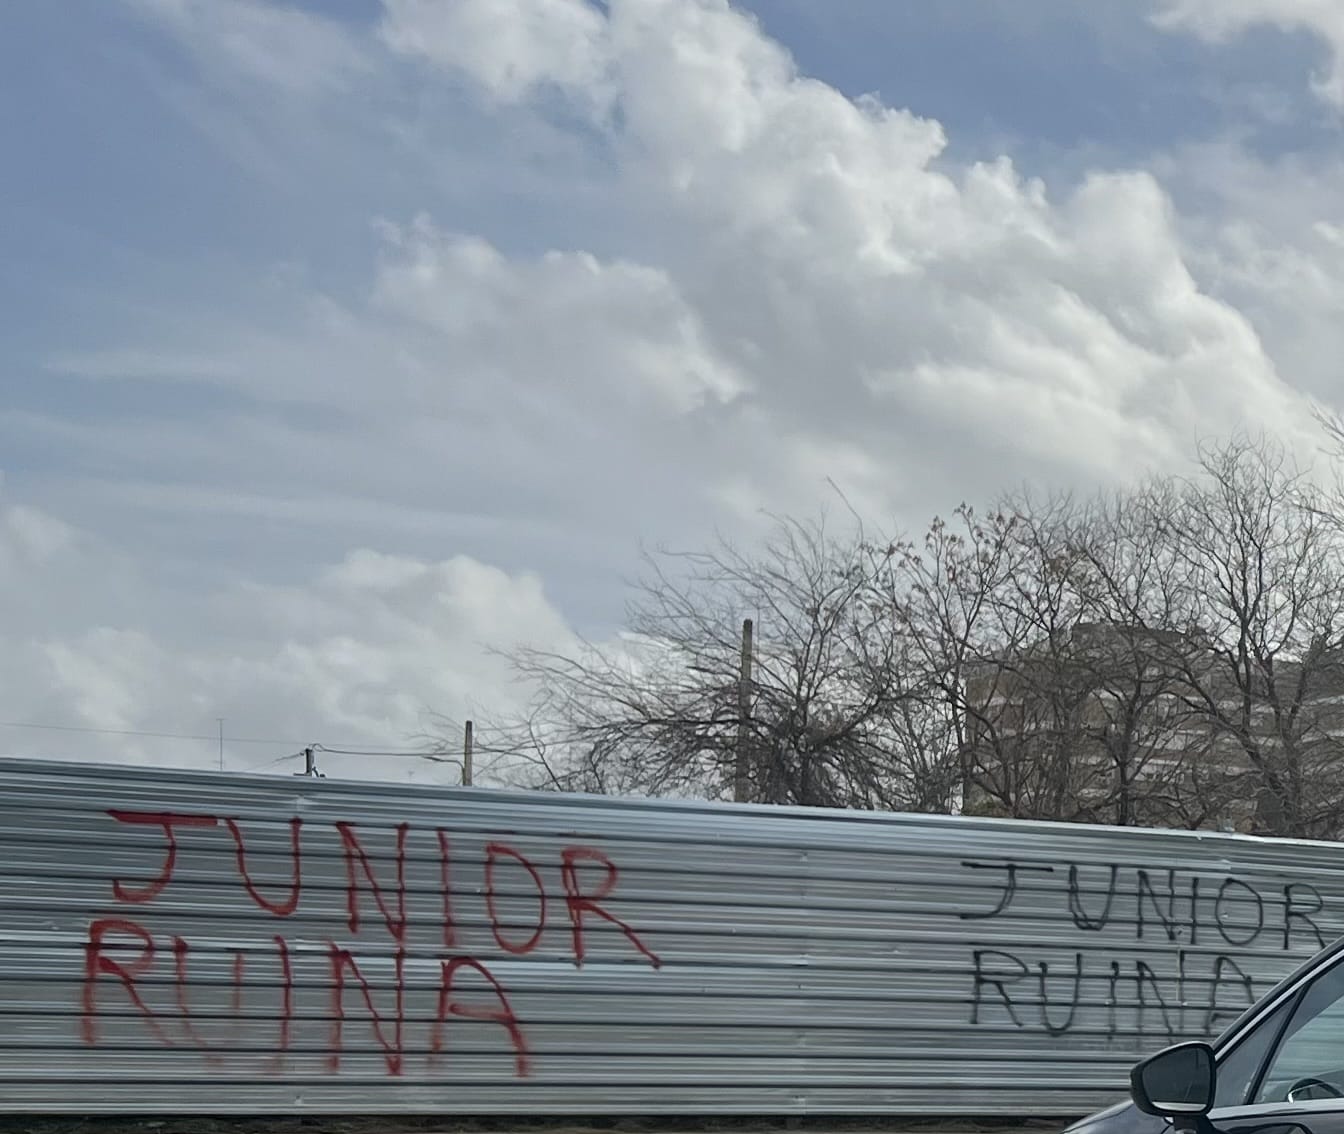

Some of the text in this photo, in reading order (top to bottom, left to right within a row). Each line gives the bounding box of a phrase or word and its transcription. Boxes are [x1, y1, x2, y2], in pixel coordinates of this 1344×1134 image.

[107, 809, 661, 970] JUNIOR
[960, 861, 1327, 951] JUNIOR
[80, 918, 534, 1078] RUINA
[970, 950, 1255, 1043] RUINA
